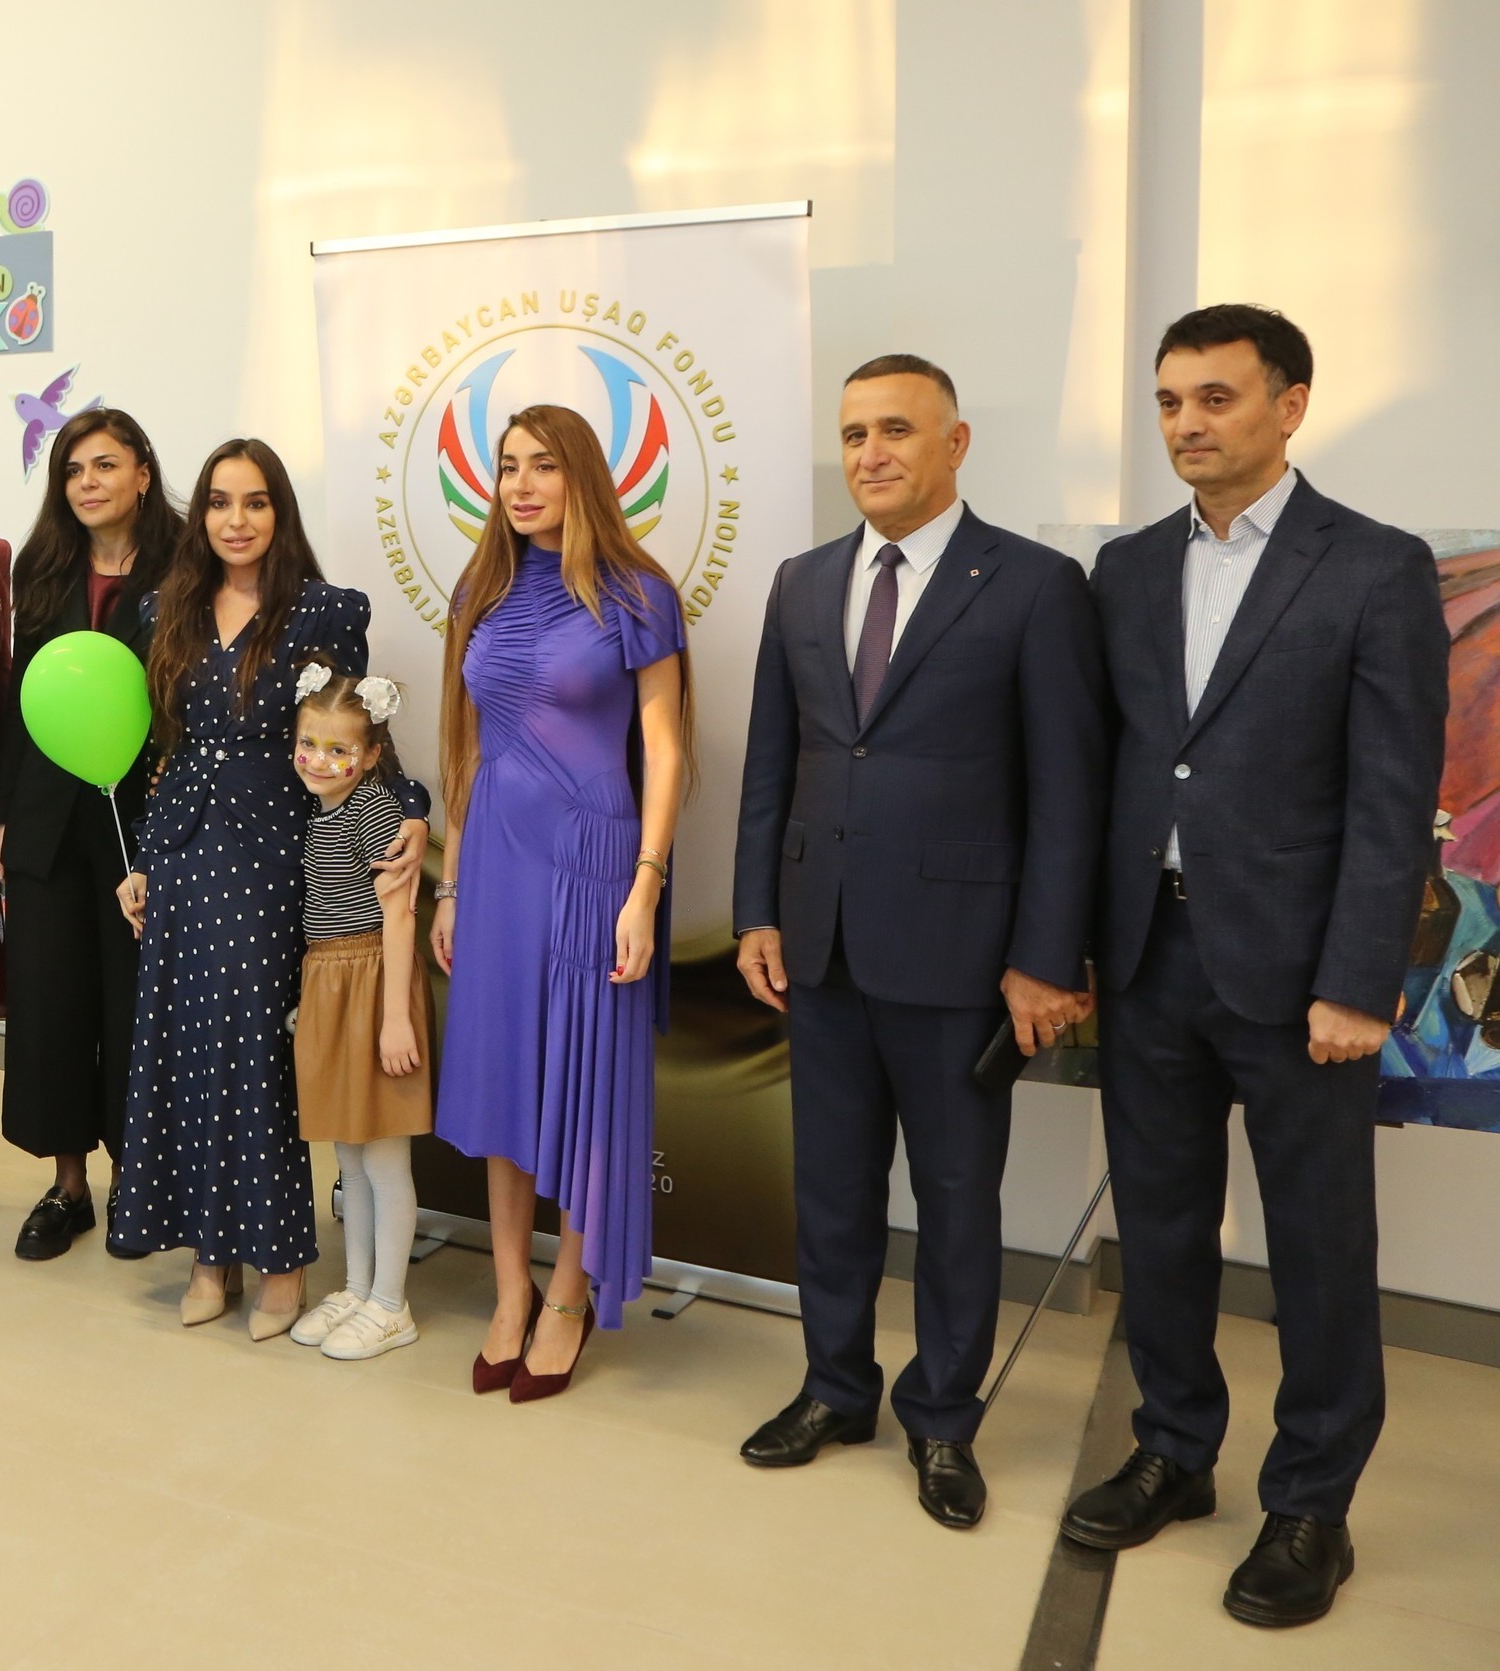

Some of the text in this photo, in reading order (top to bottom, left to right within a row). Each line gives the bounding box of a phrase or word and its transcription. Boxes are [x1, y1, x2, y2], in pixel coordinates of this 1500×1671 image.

[378, 289, 737, 450] AZƏRBAYCAN UŞAQ FONDU
[375, 495, 741, 639] AZERBAIJA NDATION
